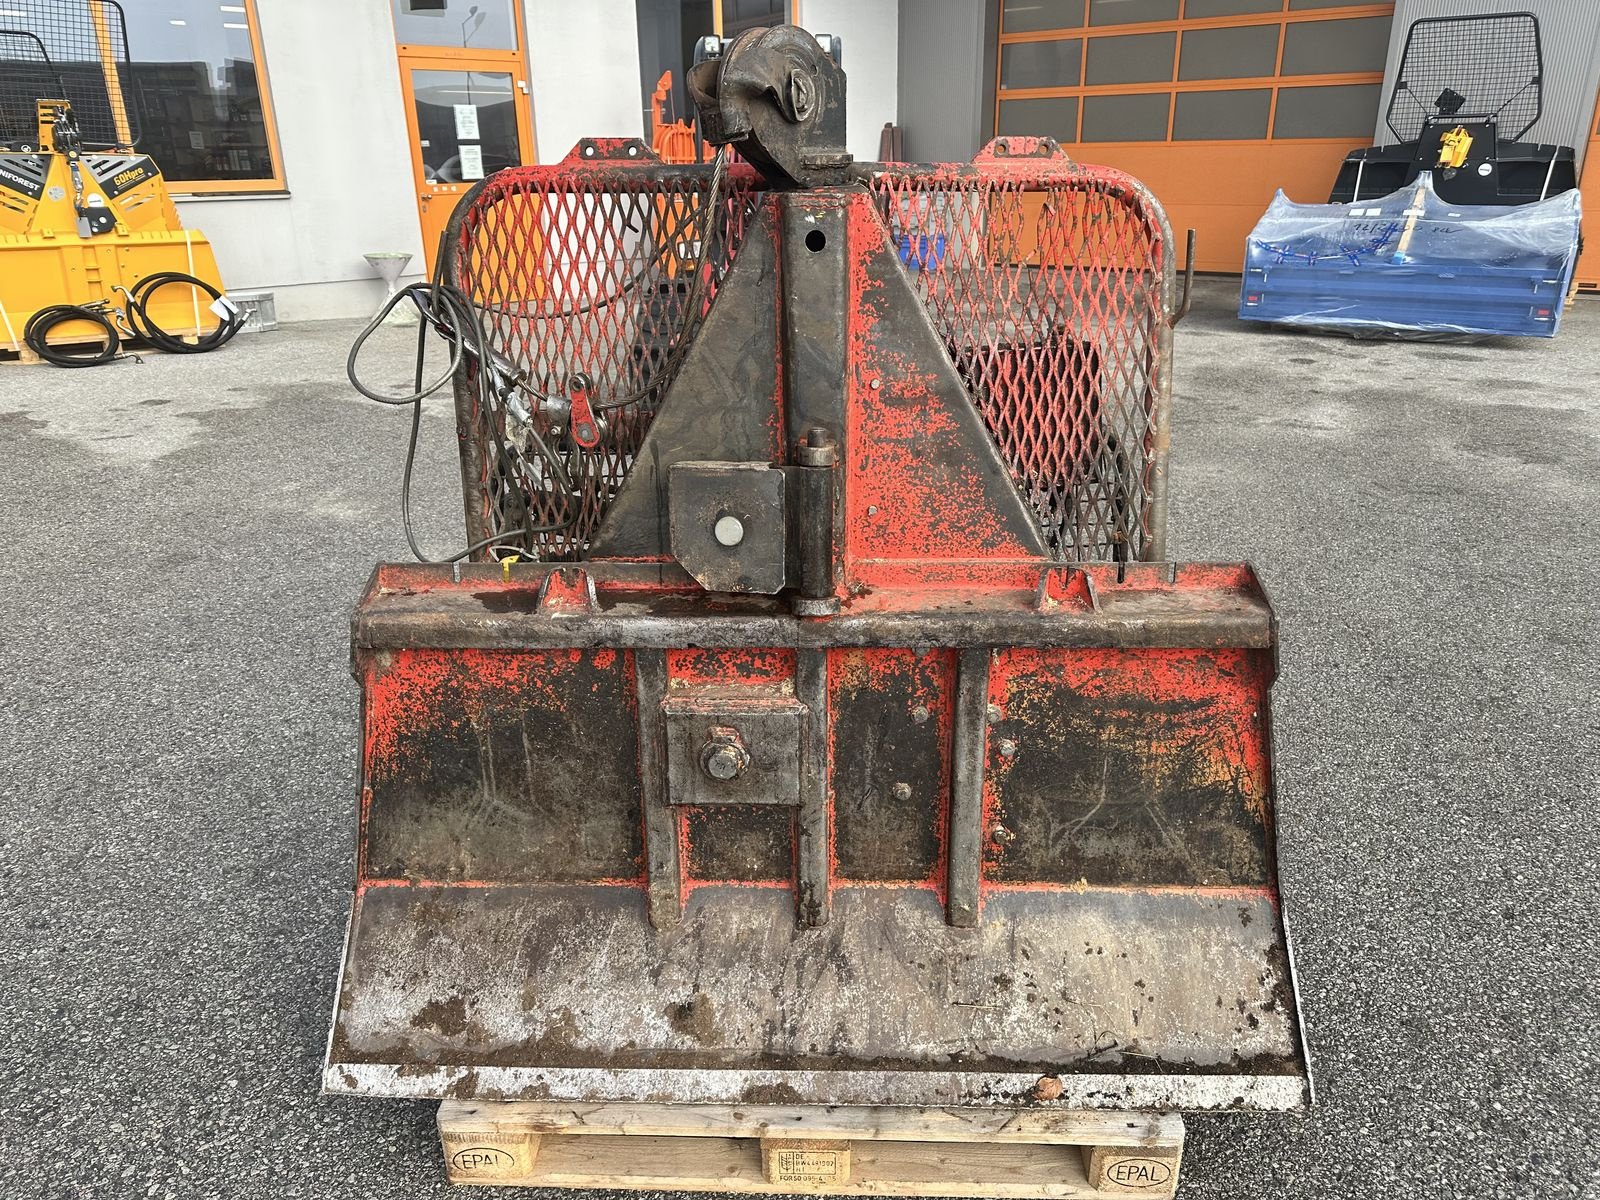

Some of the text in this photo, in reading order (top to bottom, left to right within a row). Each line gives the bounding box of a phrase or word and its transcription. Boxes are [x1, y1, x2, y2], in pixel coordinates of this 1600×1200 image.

[0, 169, 40, 190] NIFOREST
[113, 167, 144, 186] 60Hpro
[1115, 1165, 1160, 1181] EPAL
